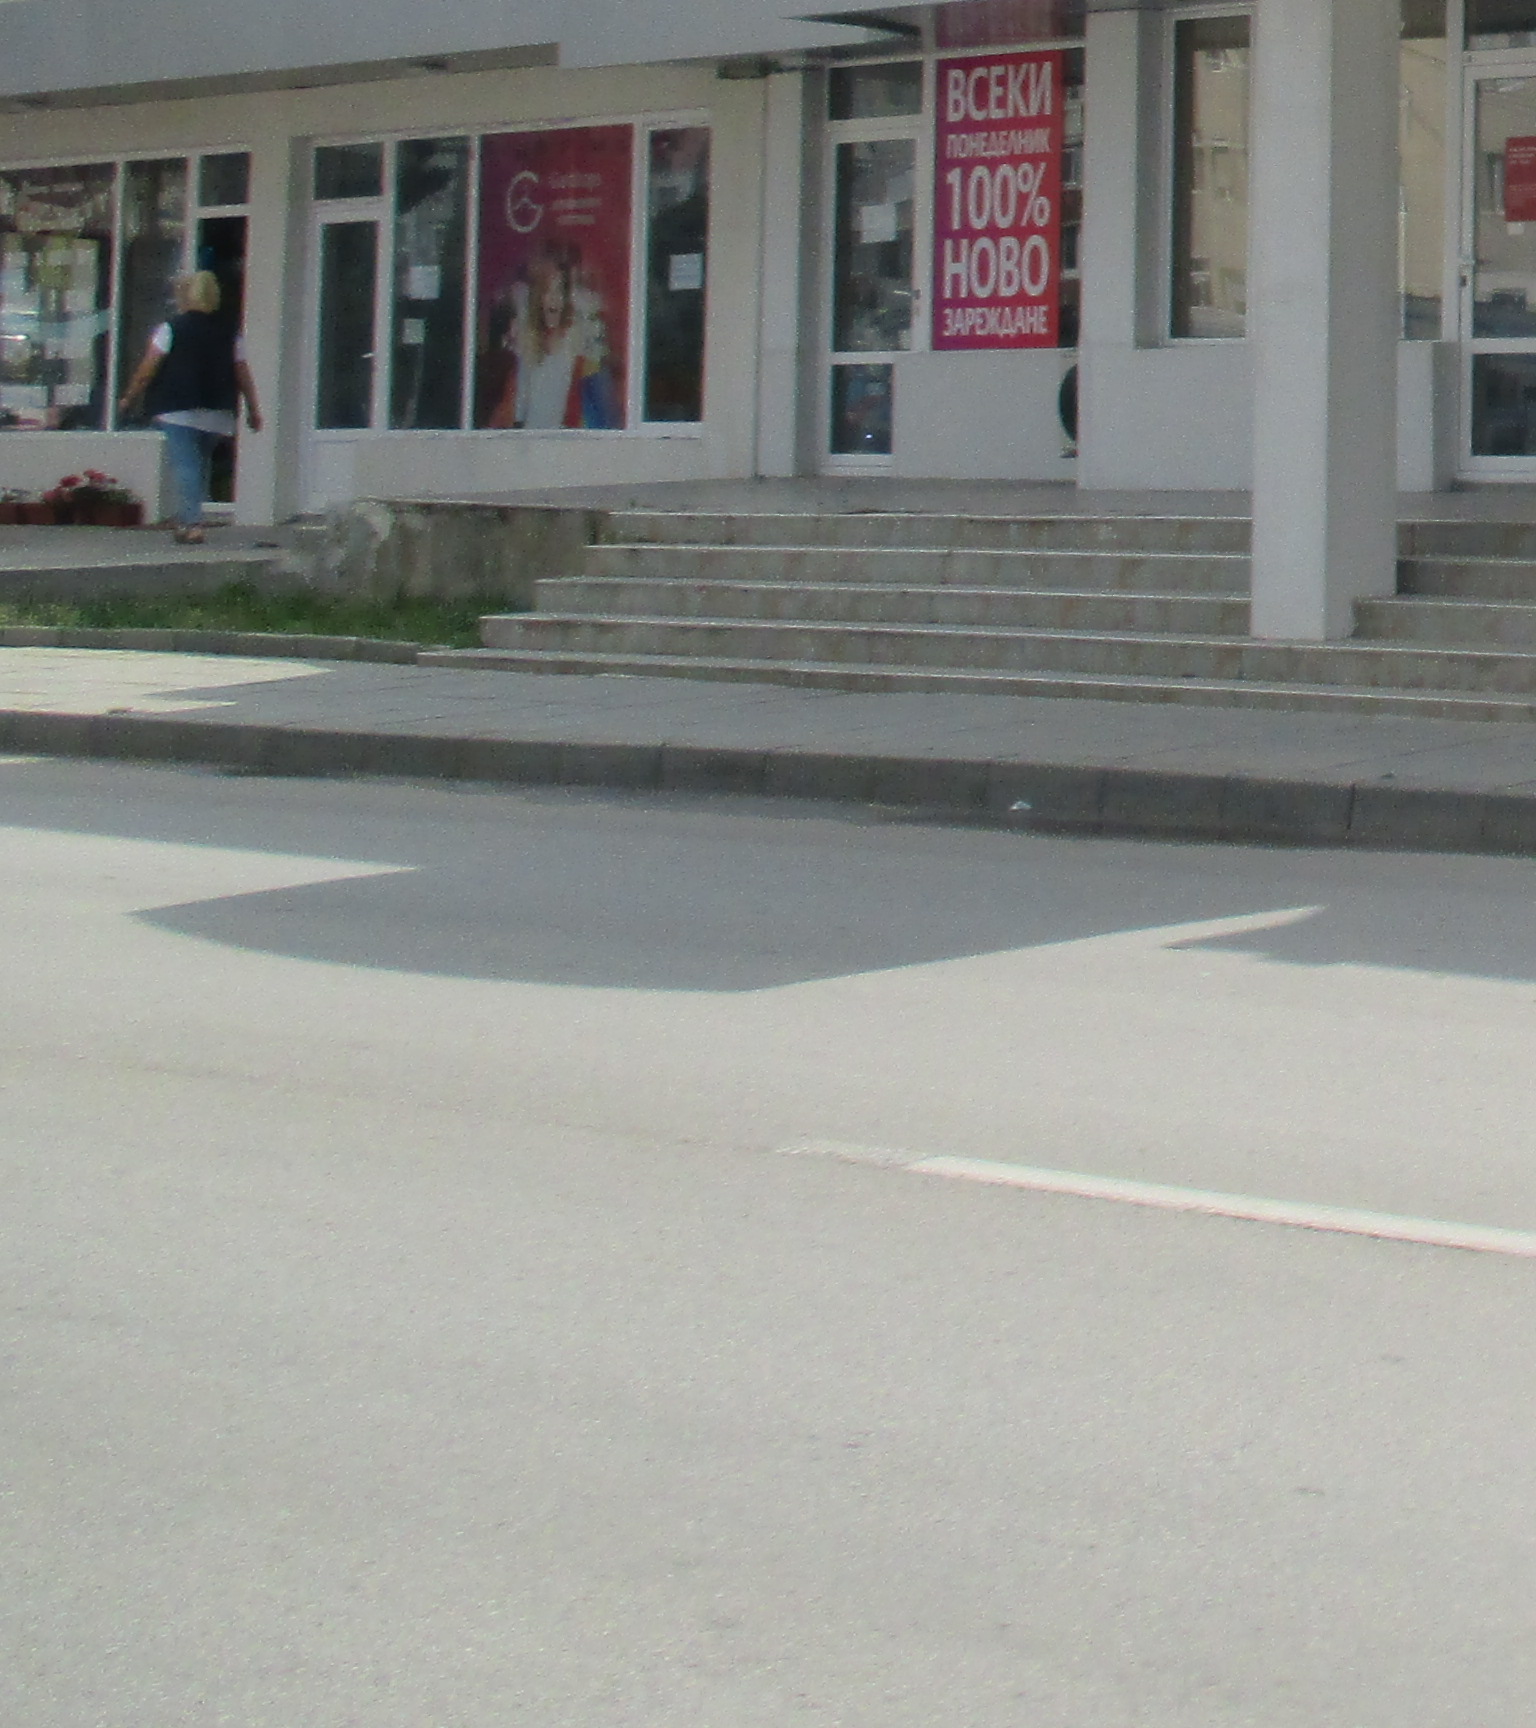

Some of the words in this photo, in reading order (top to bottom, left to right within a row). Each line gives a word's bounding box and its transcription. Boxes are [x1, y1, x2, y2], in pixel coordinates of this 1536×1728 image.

[946, 61, 1053, 123] ВСЕКИ
[946, 127, 1052, 159] ПОНЕДЕЛНИК
[946, 162, 1051, 231] 100%
[943, 234, 1050, 299] НОВО
[943, 304, 1050, 338] ЗАРЕЖДАНЕ
